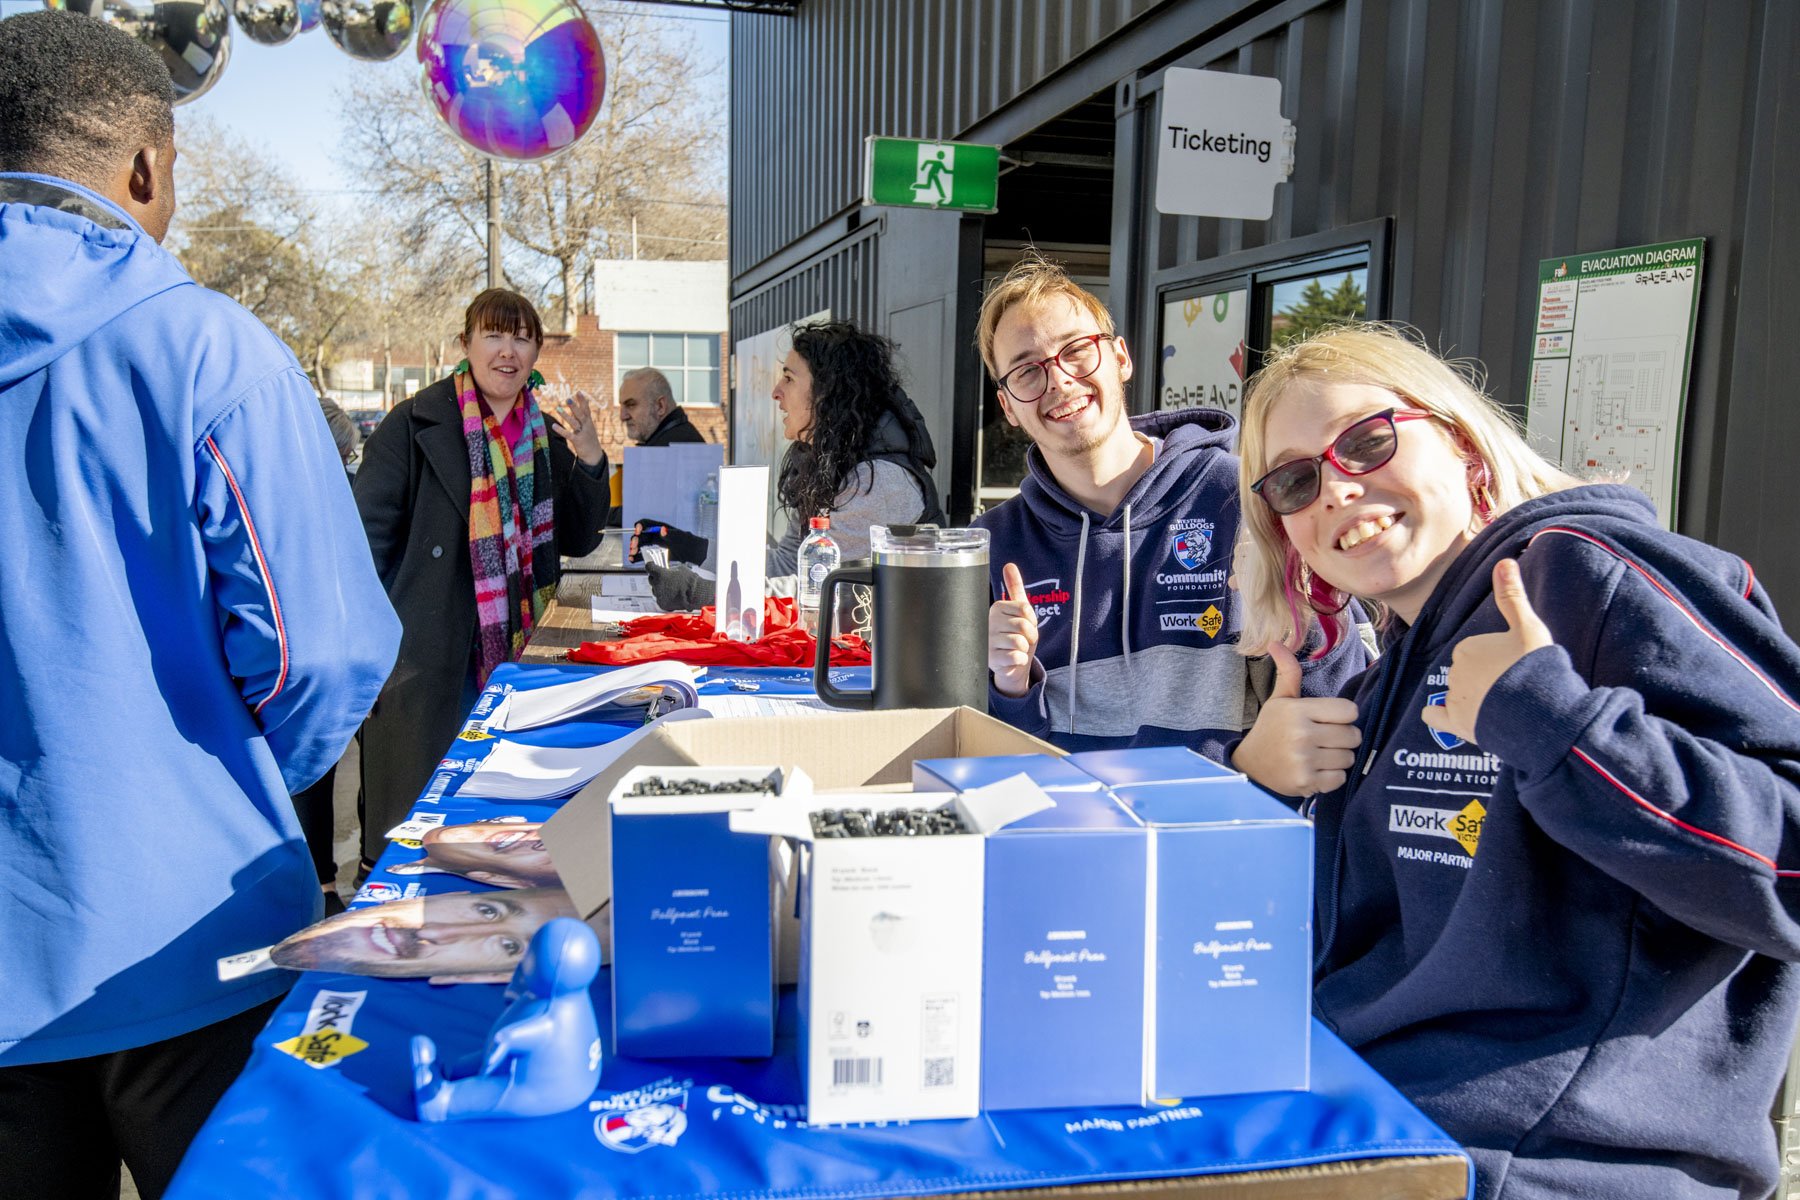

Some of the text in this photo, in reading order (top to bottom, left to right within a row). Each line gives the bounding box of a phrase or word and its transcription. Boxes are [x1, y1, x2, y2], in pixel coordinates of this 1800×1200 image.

[1168, 126, 1271, 163] Ticketing
[1581, 246, 1697, 273] EVACUATION DIAGRAM
[1635, 268, 1693, 286] GRAZELAND
[1170, 522, 1215, 531] BULLDOGS
[1156, 570, 1227, 585] Community
[1168, 584, 1222, 592] FOUNDATION
[1034, 604, 1061, 619] ject
[1163, 614, 1221, 627] Work Safe
[1393, 748, 1502, 772] Communit
[1407, 770, 1499, 785] FOUNDATION
[1395, 808, 1486, 833] Work Saf
[1397, 846, 1432, 862] MAJOR
[1065, 1106, 1203, 1134] MAJOR PARTNER
